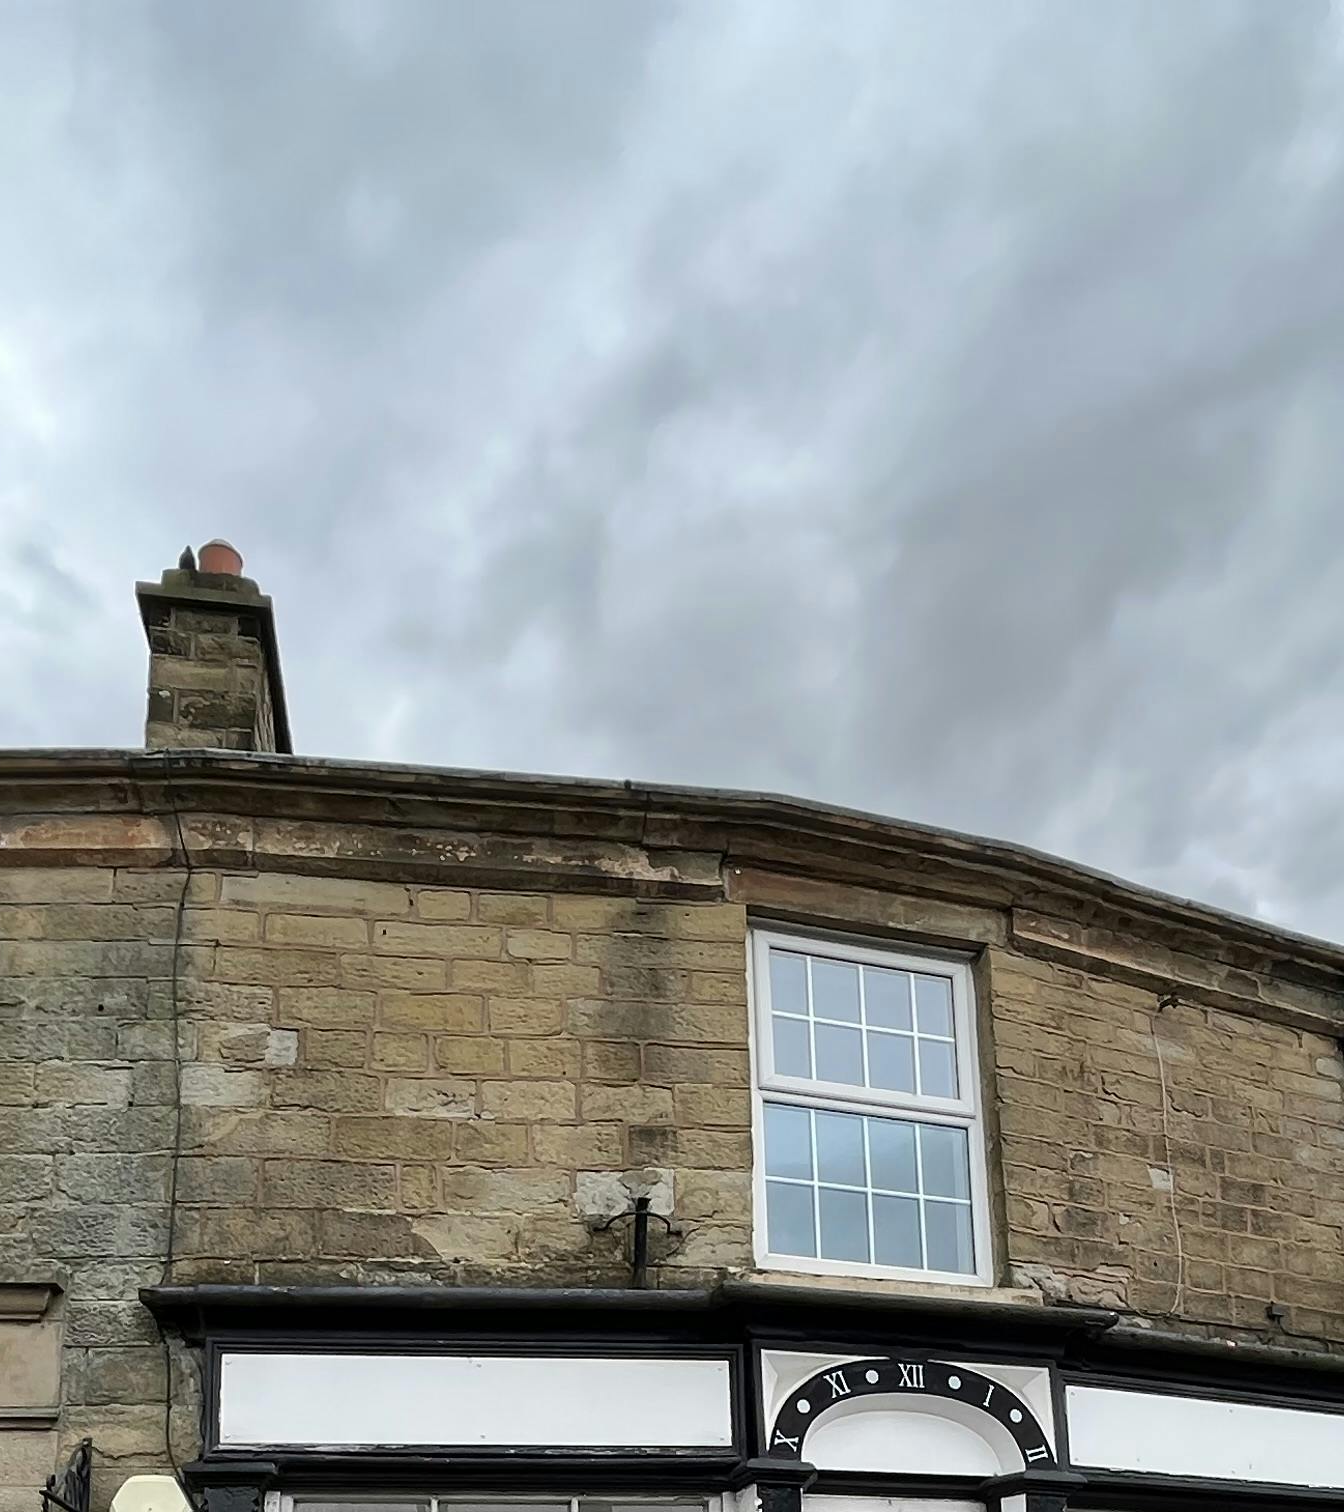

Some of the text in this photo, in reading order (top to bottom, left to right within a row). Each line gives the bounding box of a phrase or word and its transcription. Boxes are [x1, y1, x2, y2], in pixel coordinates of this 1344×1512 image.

[774, 1363, 1049, 1463] X XI XII I II
